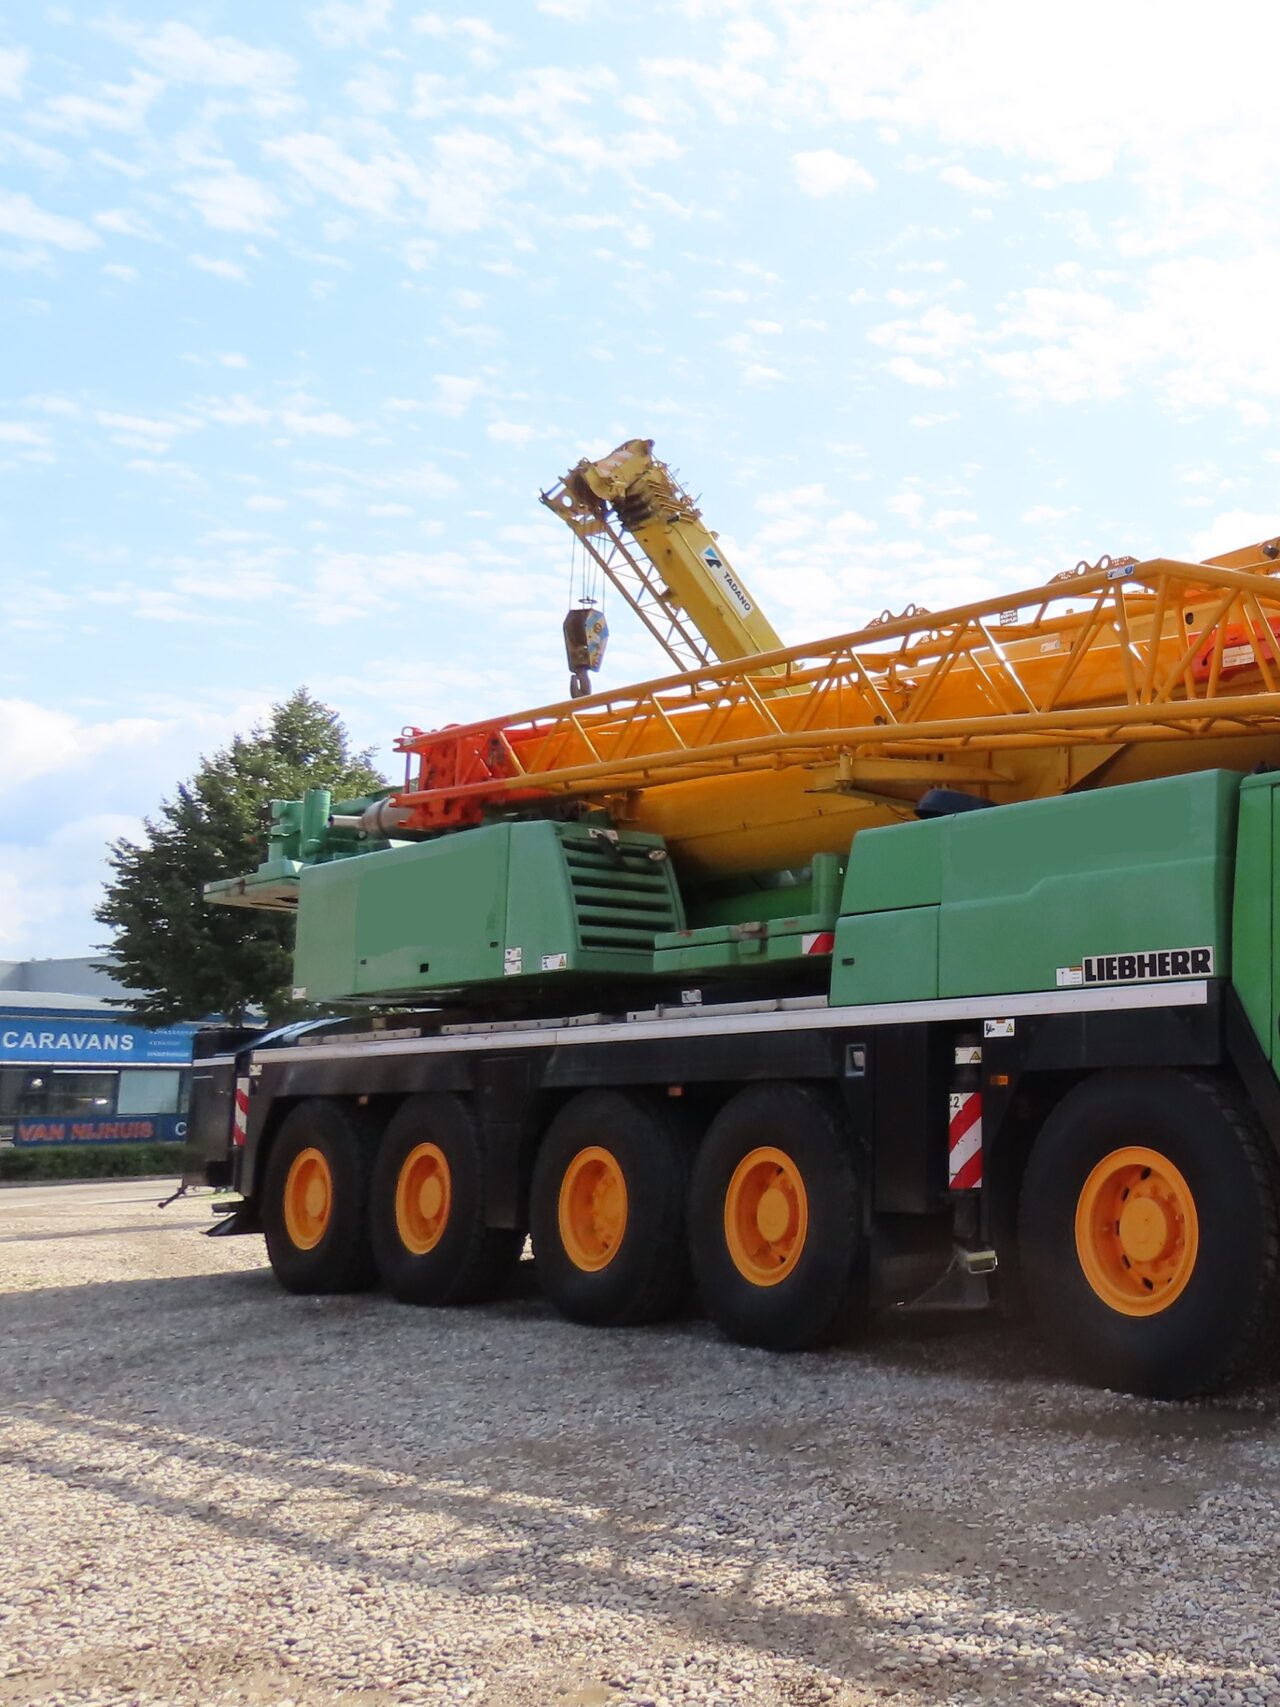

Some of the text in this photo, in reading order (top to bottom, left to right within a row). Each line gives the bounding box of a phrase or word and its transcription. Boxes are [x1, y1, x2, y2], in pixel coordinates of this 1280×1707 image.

[723, 571, 751, 611] TADANO
[1084, 949, 1211, 982] LIEBHERR
[2, 1031, 134, 1050] CARAVANS
[19, 1121, 153, 1141] VAN NIJHUIS
